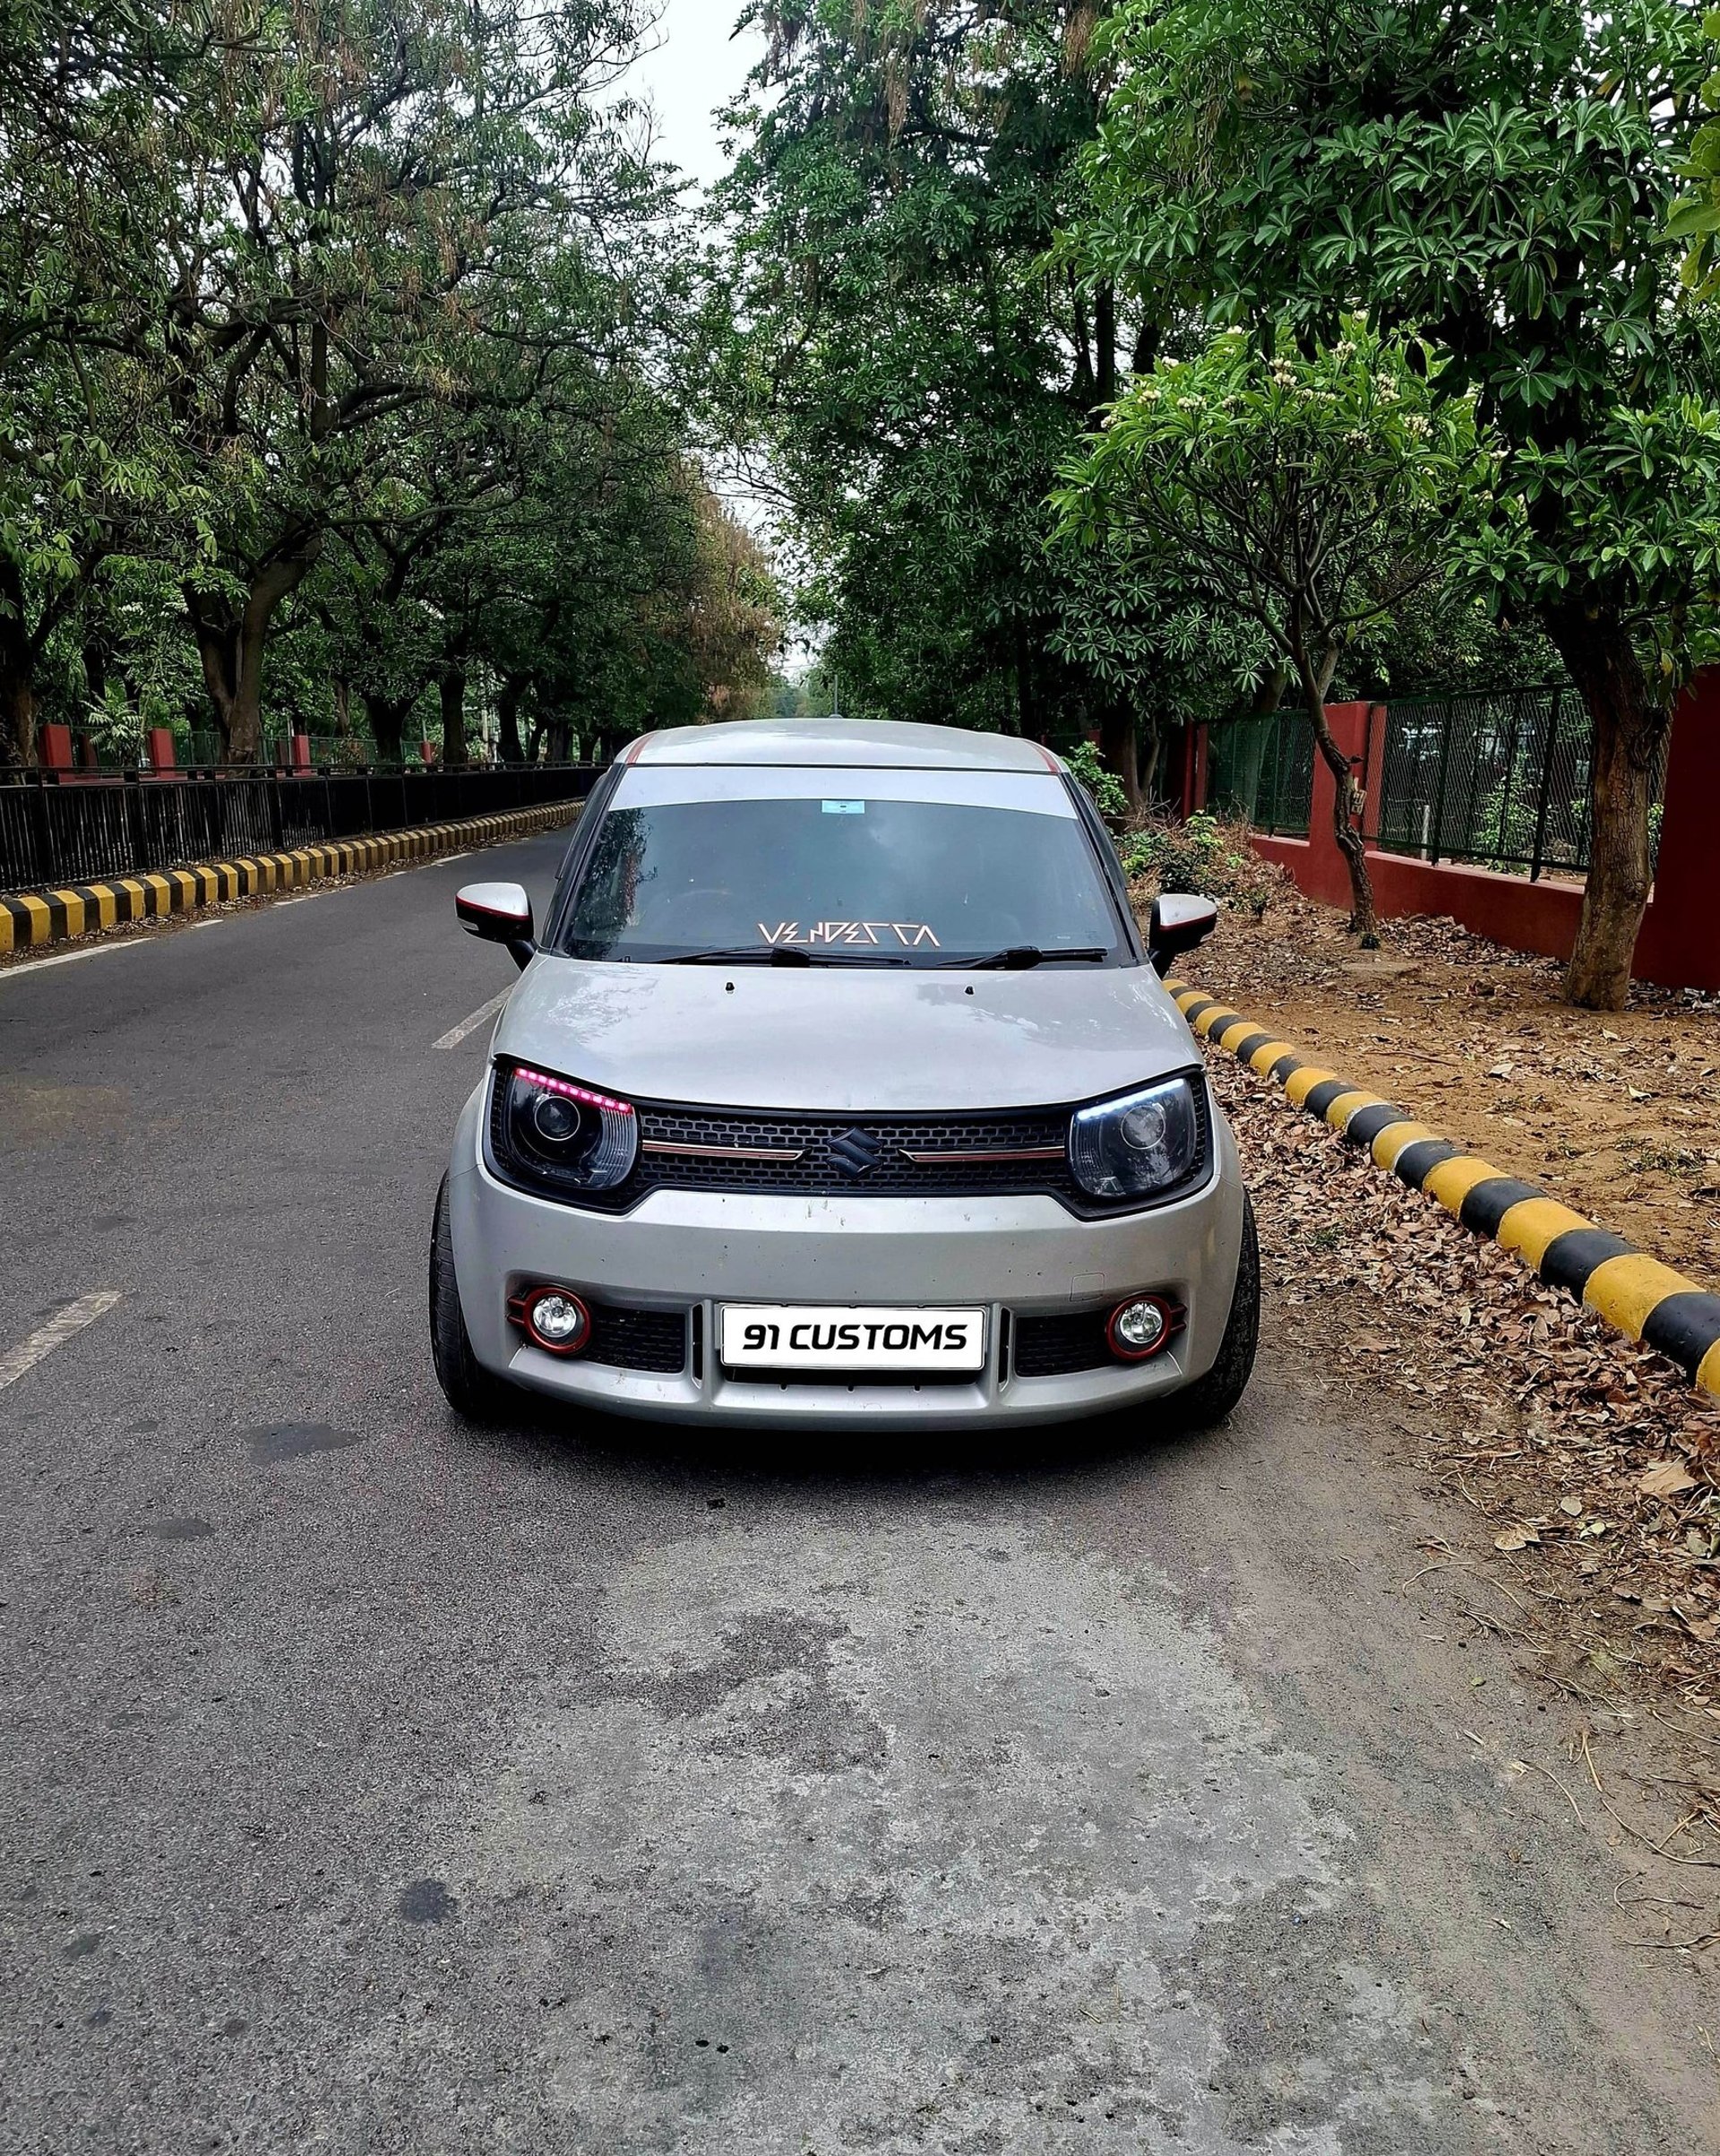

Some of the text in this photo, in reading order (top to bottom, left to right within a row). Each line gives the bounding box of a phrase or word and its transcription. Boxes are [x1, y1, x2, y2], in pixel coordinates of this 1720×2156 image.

[758, 921, 941, 946] VENDETTA
[742, 1324, 968, 1350] 91 CUSTOMS
